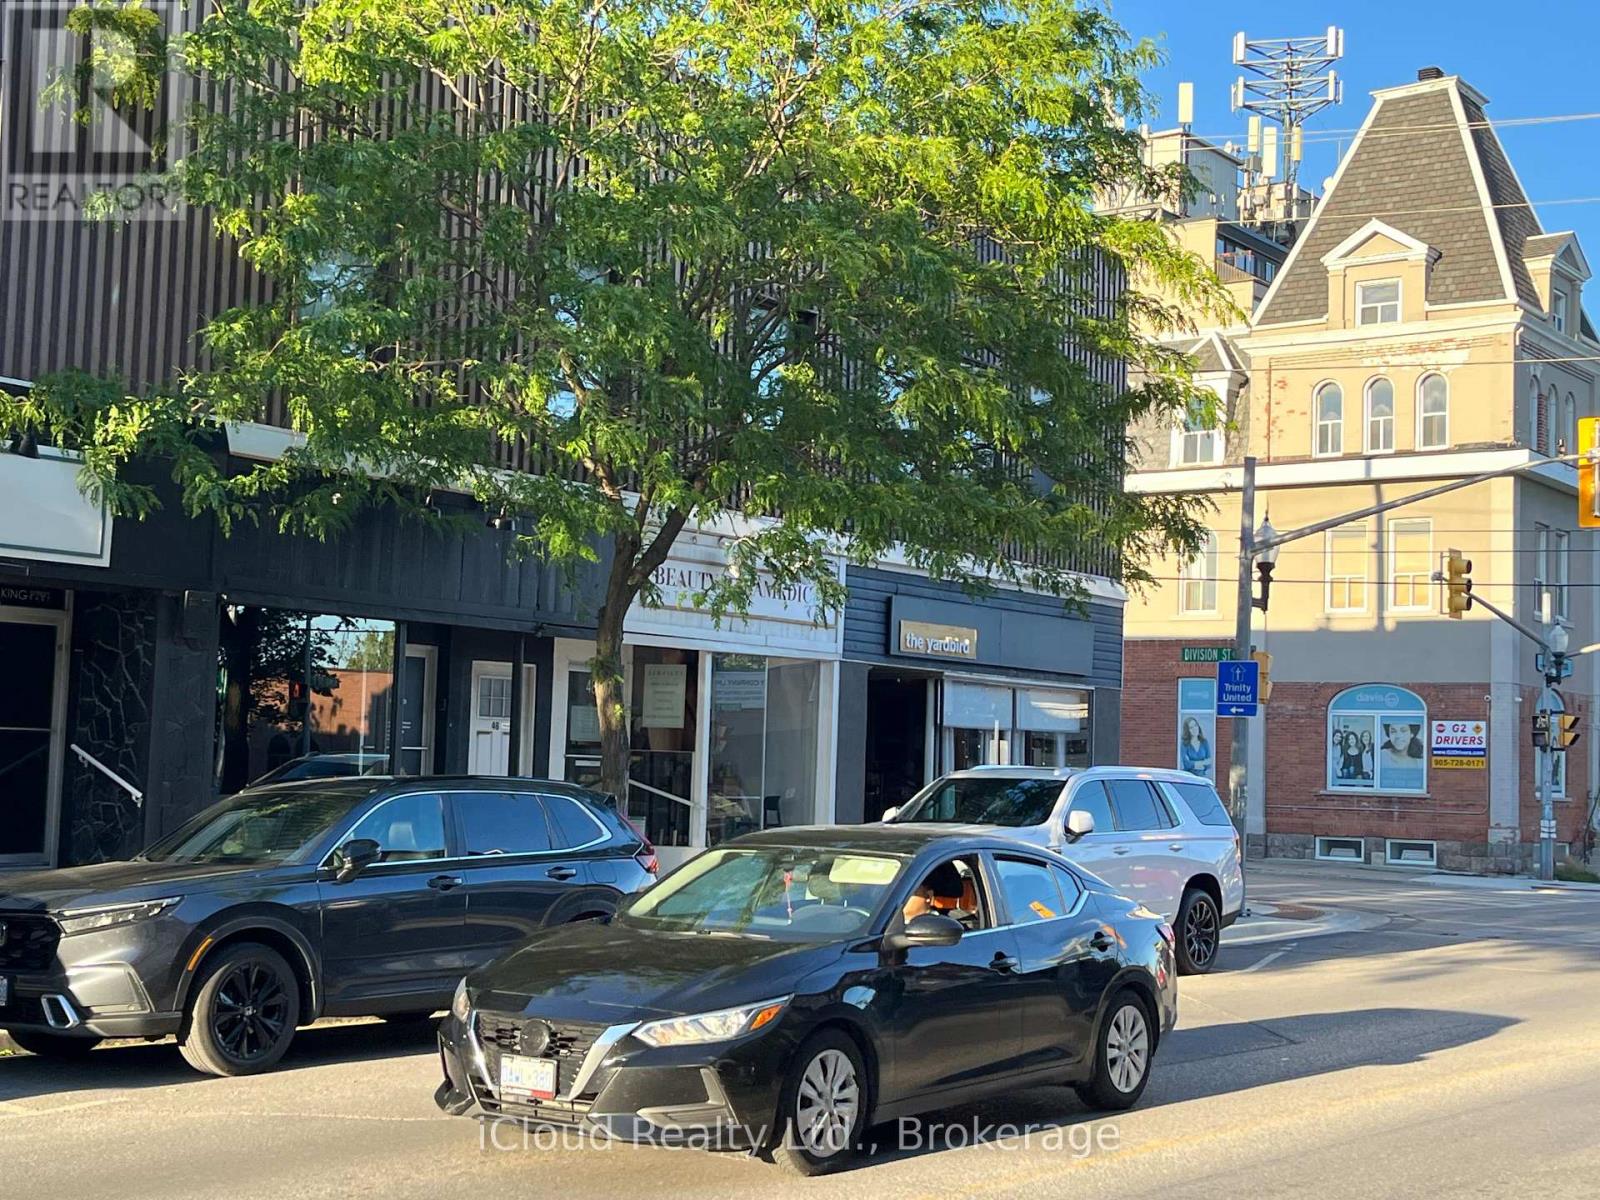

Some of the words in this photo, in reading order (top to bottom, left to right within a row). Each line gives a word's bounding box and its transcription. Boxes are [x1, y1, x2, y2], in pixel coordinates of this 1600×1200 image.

[655, 566, 718, 590] BEAUTY
[906, 632, 923, 649] the
[926, 636, 970, 654] yardbird
[1184, 648, 1218, 661] DIVISION
[1222, 648, 1232, 661] ST
[1224, 683, 1251, 693] Trinity
[1223, 693, 1252, 702] United
[1452, 723, 1467, 733] G2
[1435, 735, 1484, 745] DRIVERS
